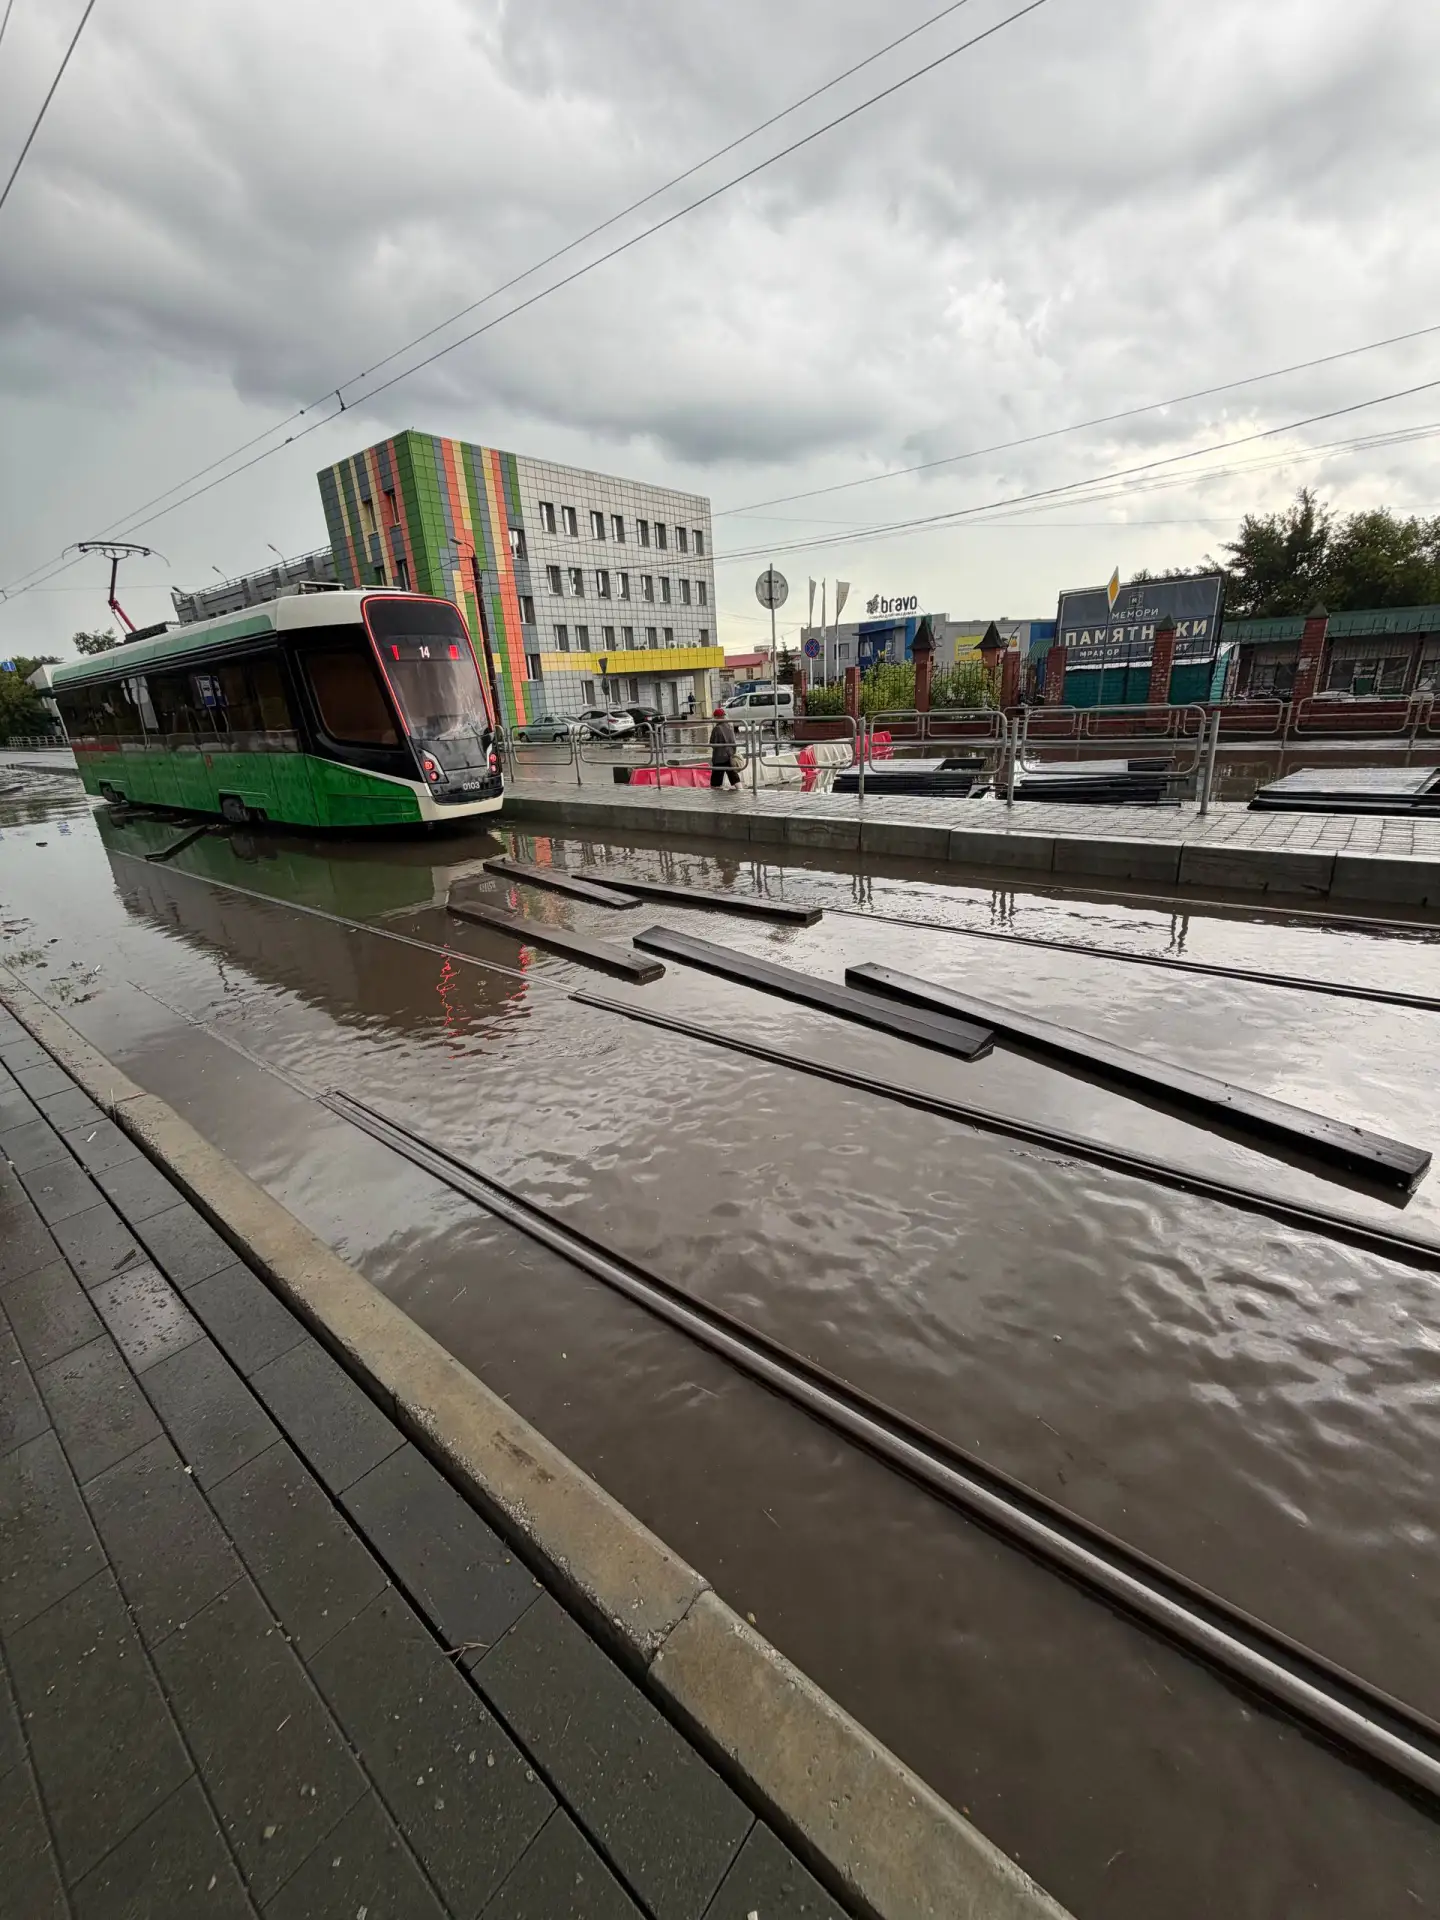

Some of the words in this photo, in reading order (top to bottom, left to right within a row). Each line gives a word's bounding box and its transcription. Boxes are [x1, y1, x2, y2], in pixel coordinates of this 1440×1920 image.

[881, 596, 917, 613] bravo
[1111, 608, 1159, 620] МЕМОРИ
[1065, 619, 1207, 646] ПАМЯТНКИ
[419, 645, 430, 659] 14
[462, 781, 480, 790] 0103
